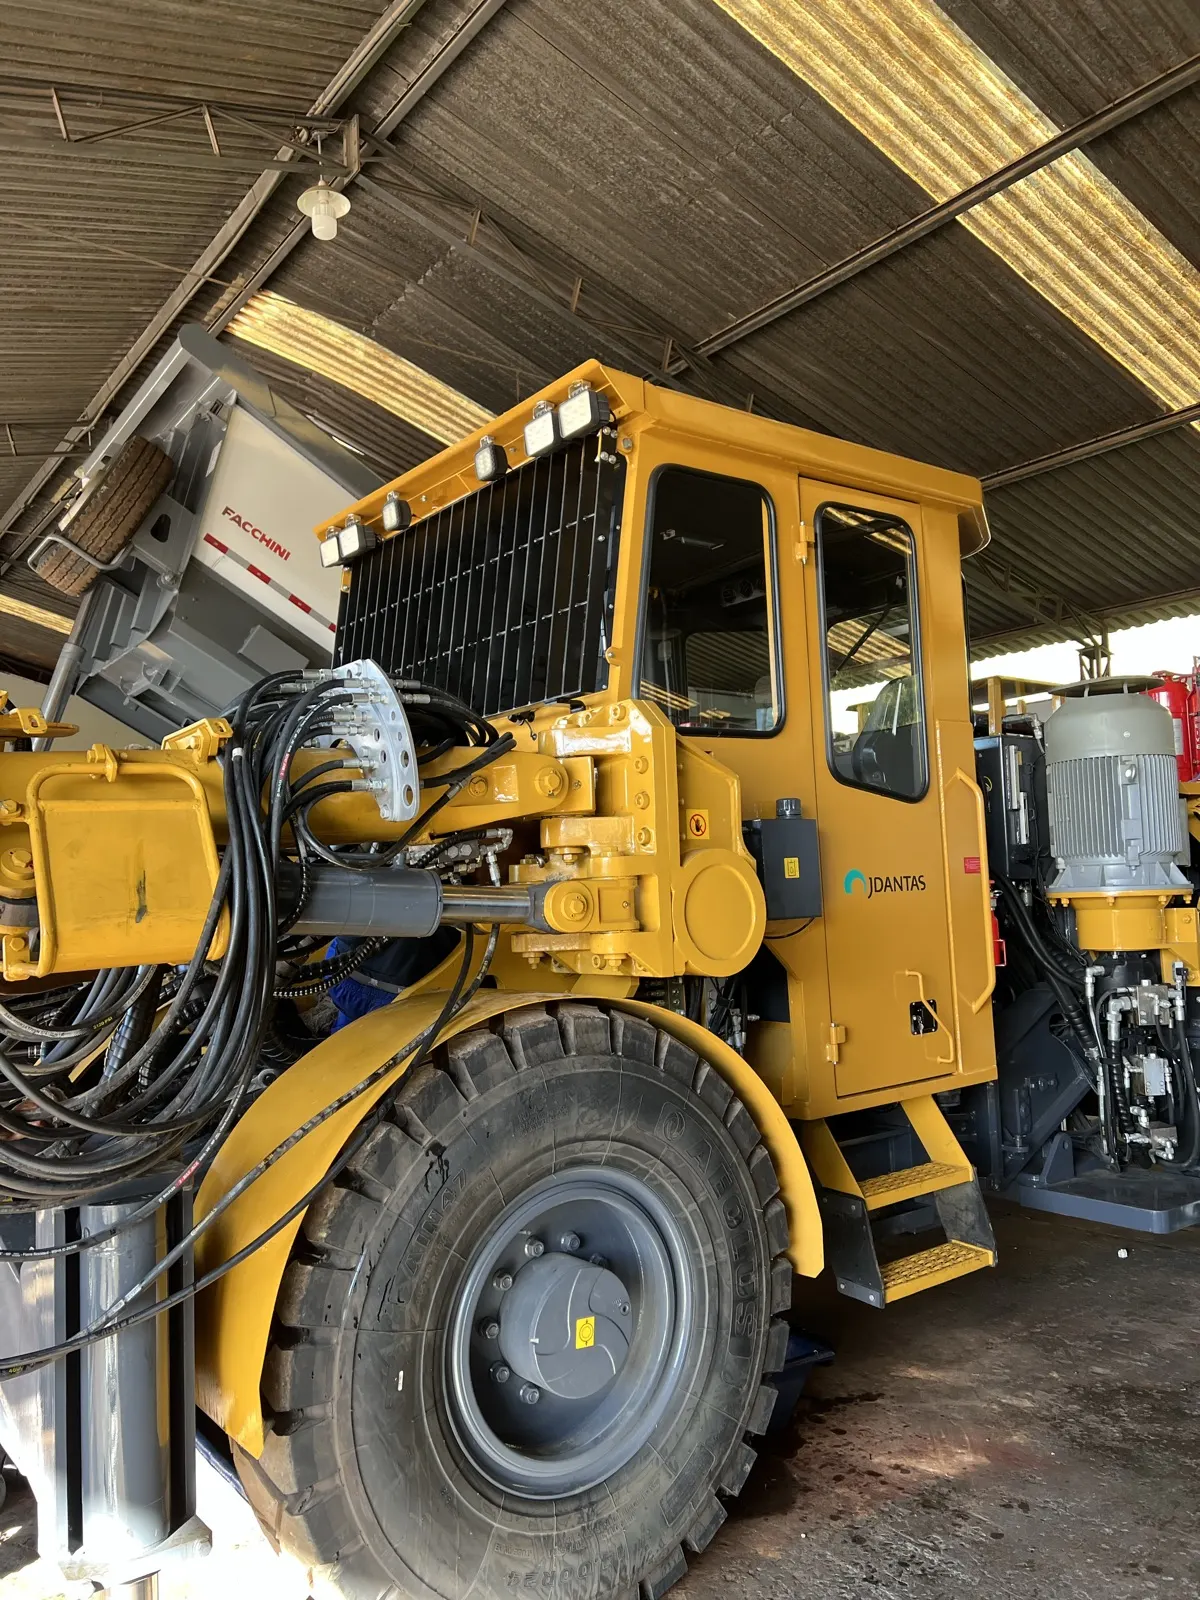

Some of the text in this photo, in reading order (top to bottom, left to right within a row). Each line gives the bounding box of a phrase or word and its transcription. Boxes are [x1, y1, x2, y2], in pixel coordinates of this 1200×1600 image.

[221, 505, 292, 561] FACCHINI
[867, 874, 927, 899] JDANTAS
[685, 1141, 758, 1338] AEOLUS
